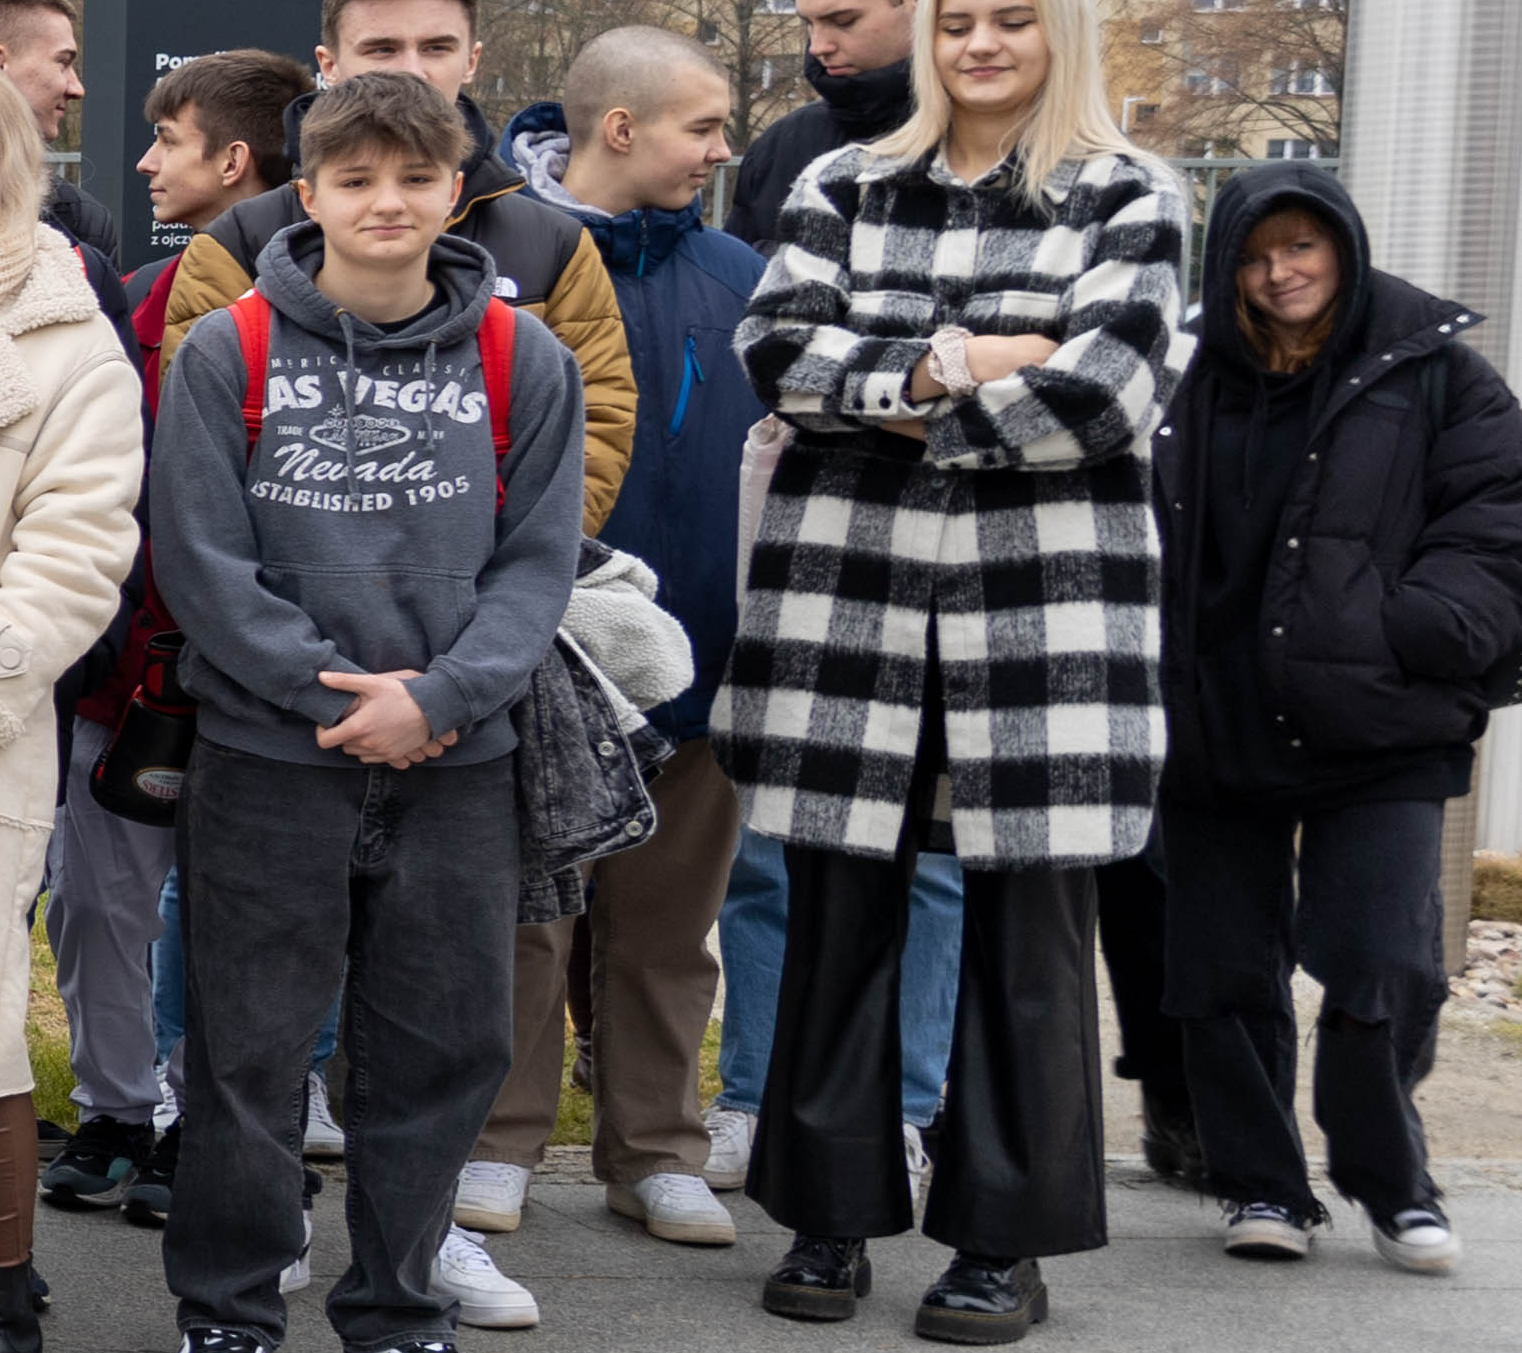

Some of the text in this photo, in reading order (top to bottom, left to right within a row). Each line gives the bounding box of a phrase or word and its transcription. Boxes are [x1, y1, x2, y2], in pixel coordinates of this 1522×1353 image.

[151, 237, 158, 245] z
[262, 370, 488, 424] AS VEGAS
[417, 430, 445, 440] MRK
[274, 443, 438, 483] Nevada
[405, 475, 471, 506] 1905
